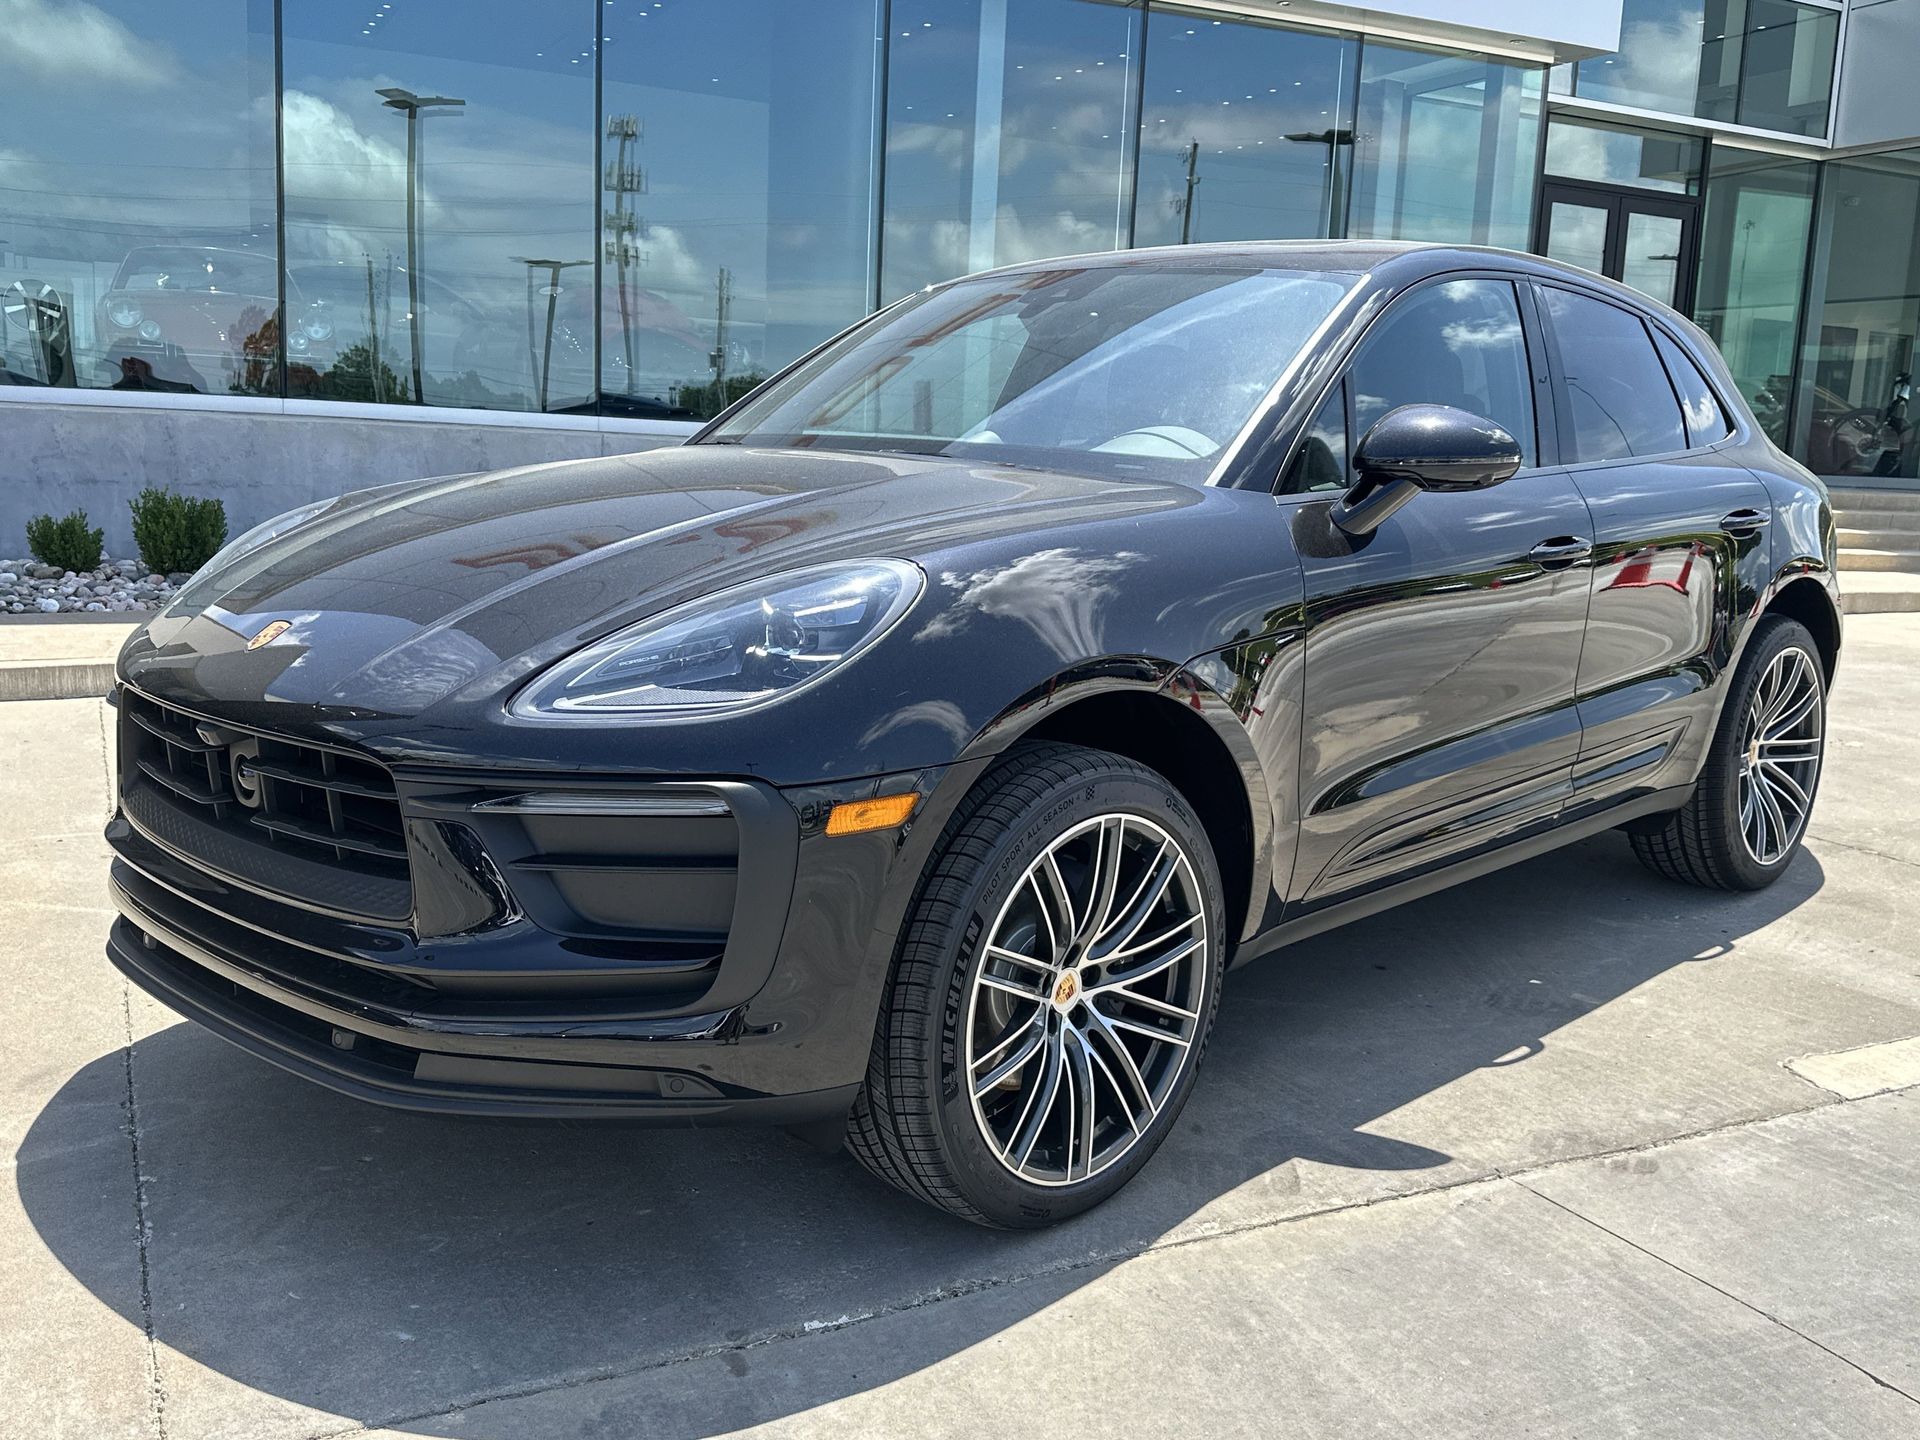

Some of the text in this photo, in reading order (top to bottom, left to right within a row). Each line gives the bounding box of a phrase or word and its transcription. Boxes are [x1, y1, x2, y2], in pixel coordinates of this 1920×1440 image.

[982, 872, 1001, 904] PILOT
[1001, 839, 1025, 872] SPORT
[1027, 825, 1042, 840] ALL
[1043, 798, 1074, 824] SEASON
[943, 920, 980, 1065] MICHELIN
